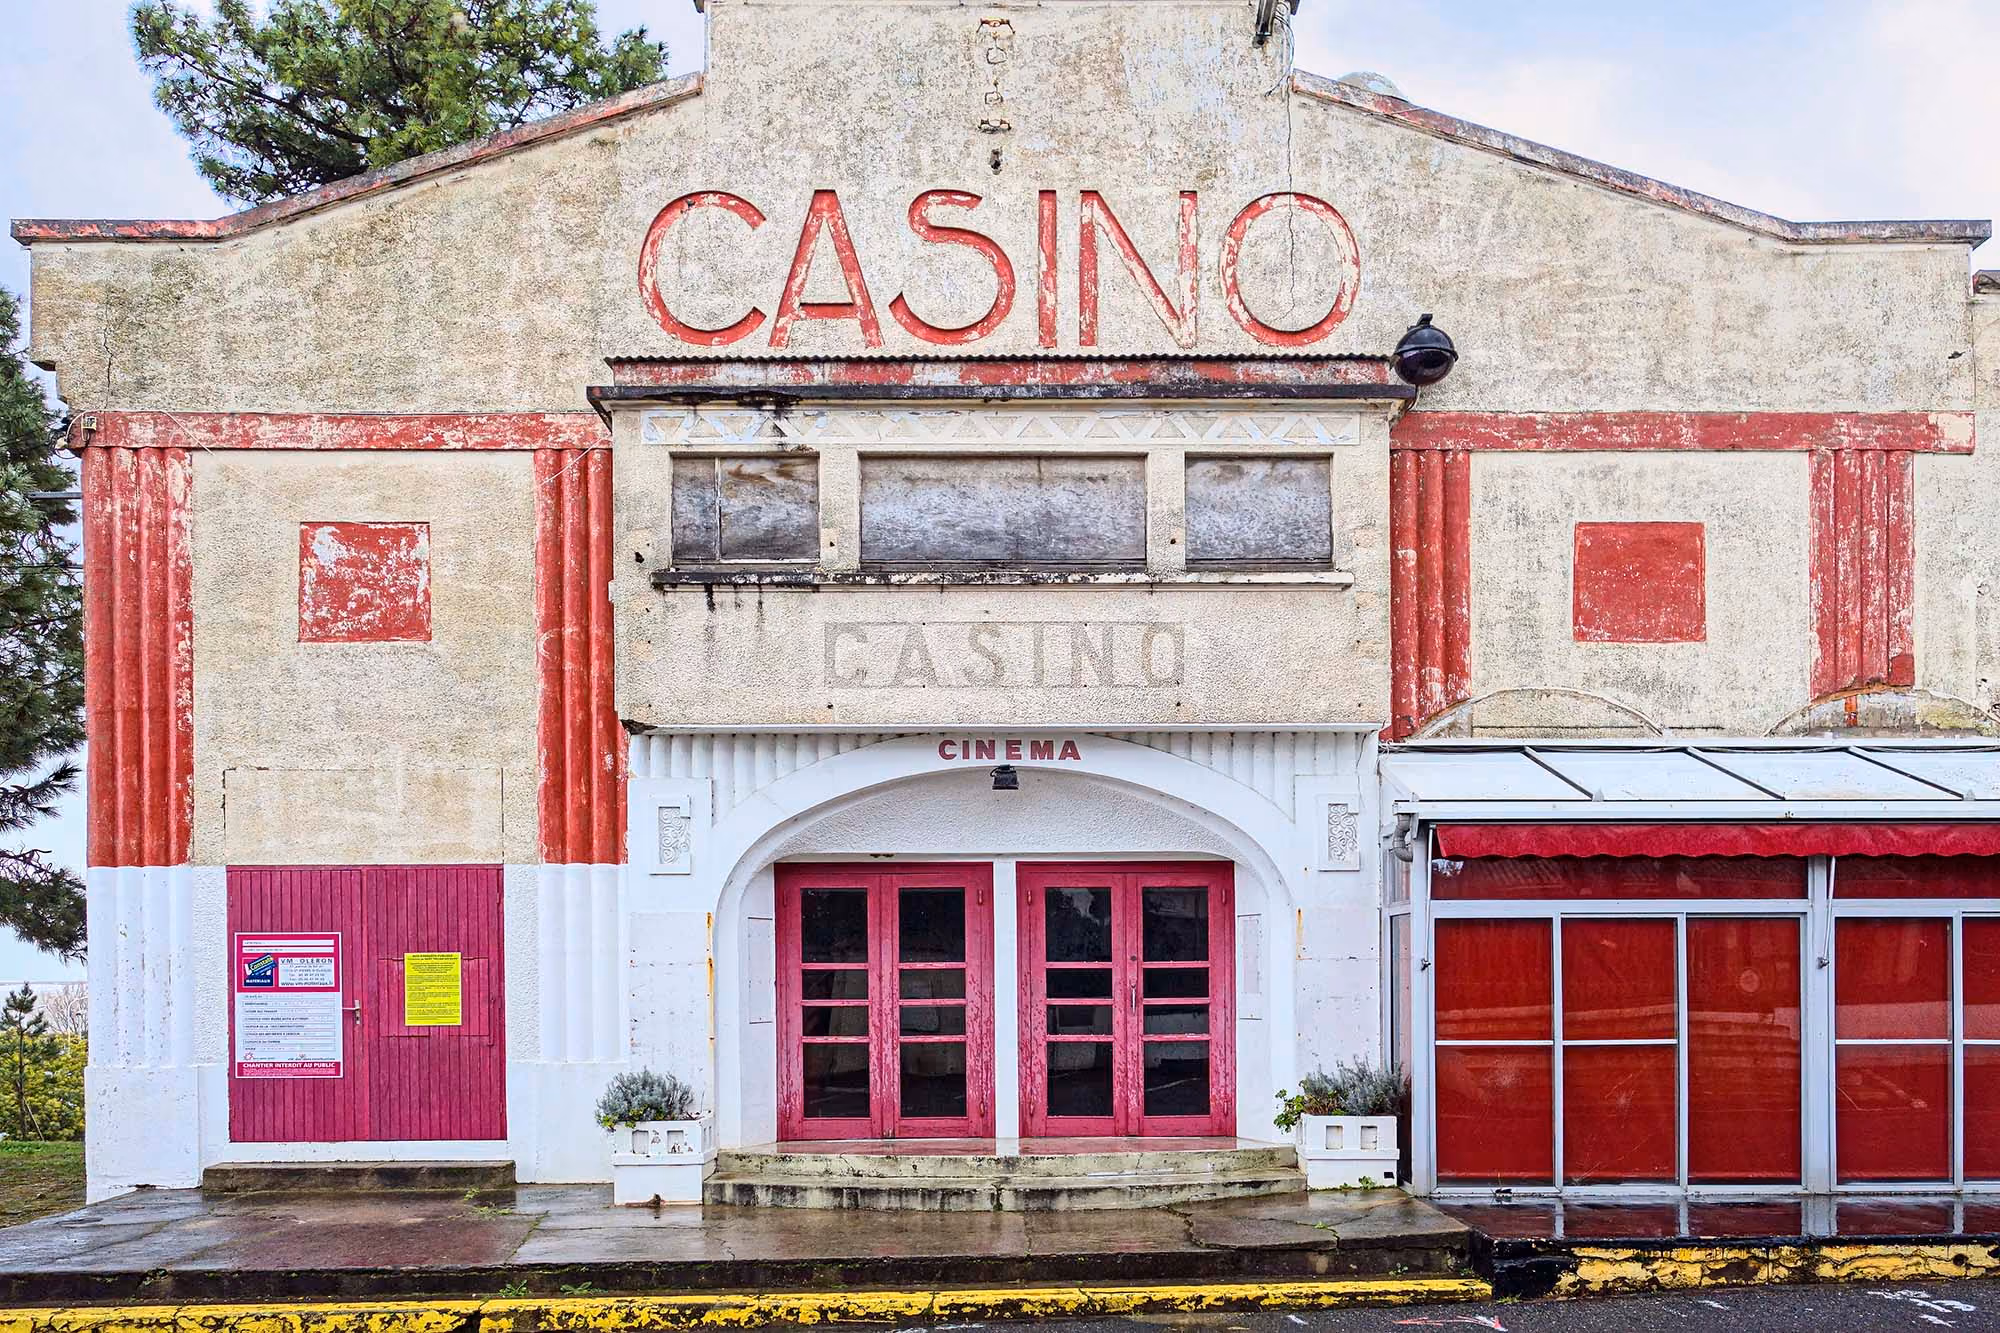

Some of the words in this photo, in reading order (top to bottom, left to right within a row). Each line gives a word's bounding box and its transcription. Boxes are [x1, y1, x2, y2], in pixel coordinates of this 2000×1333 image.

[637, 189, 1361, 349] CASINO
[824, 621, 1186, 687] CASINO
[937, 739, 1082, 761] CINEMA
